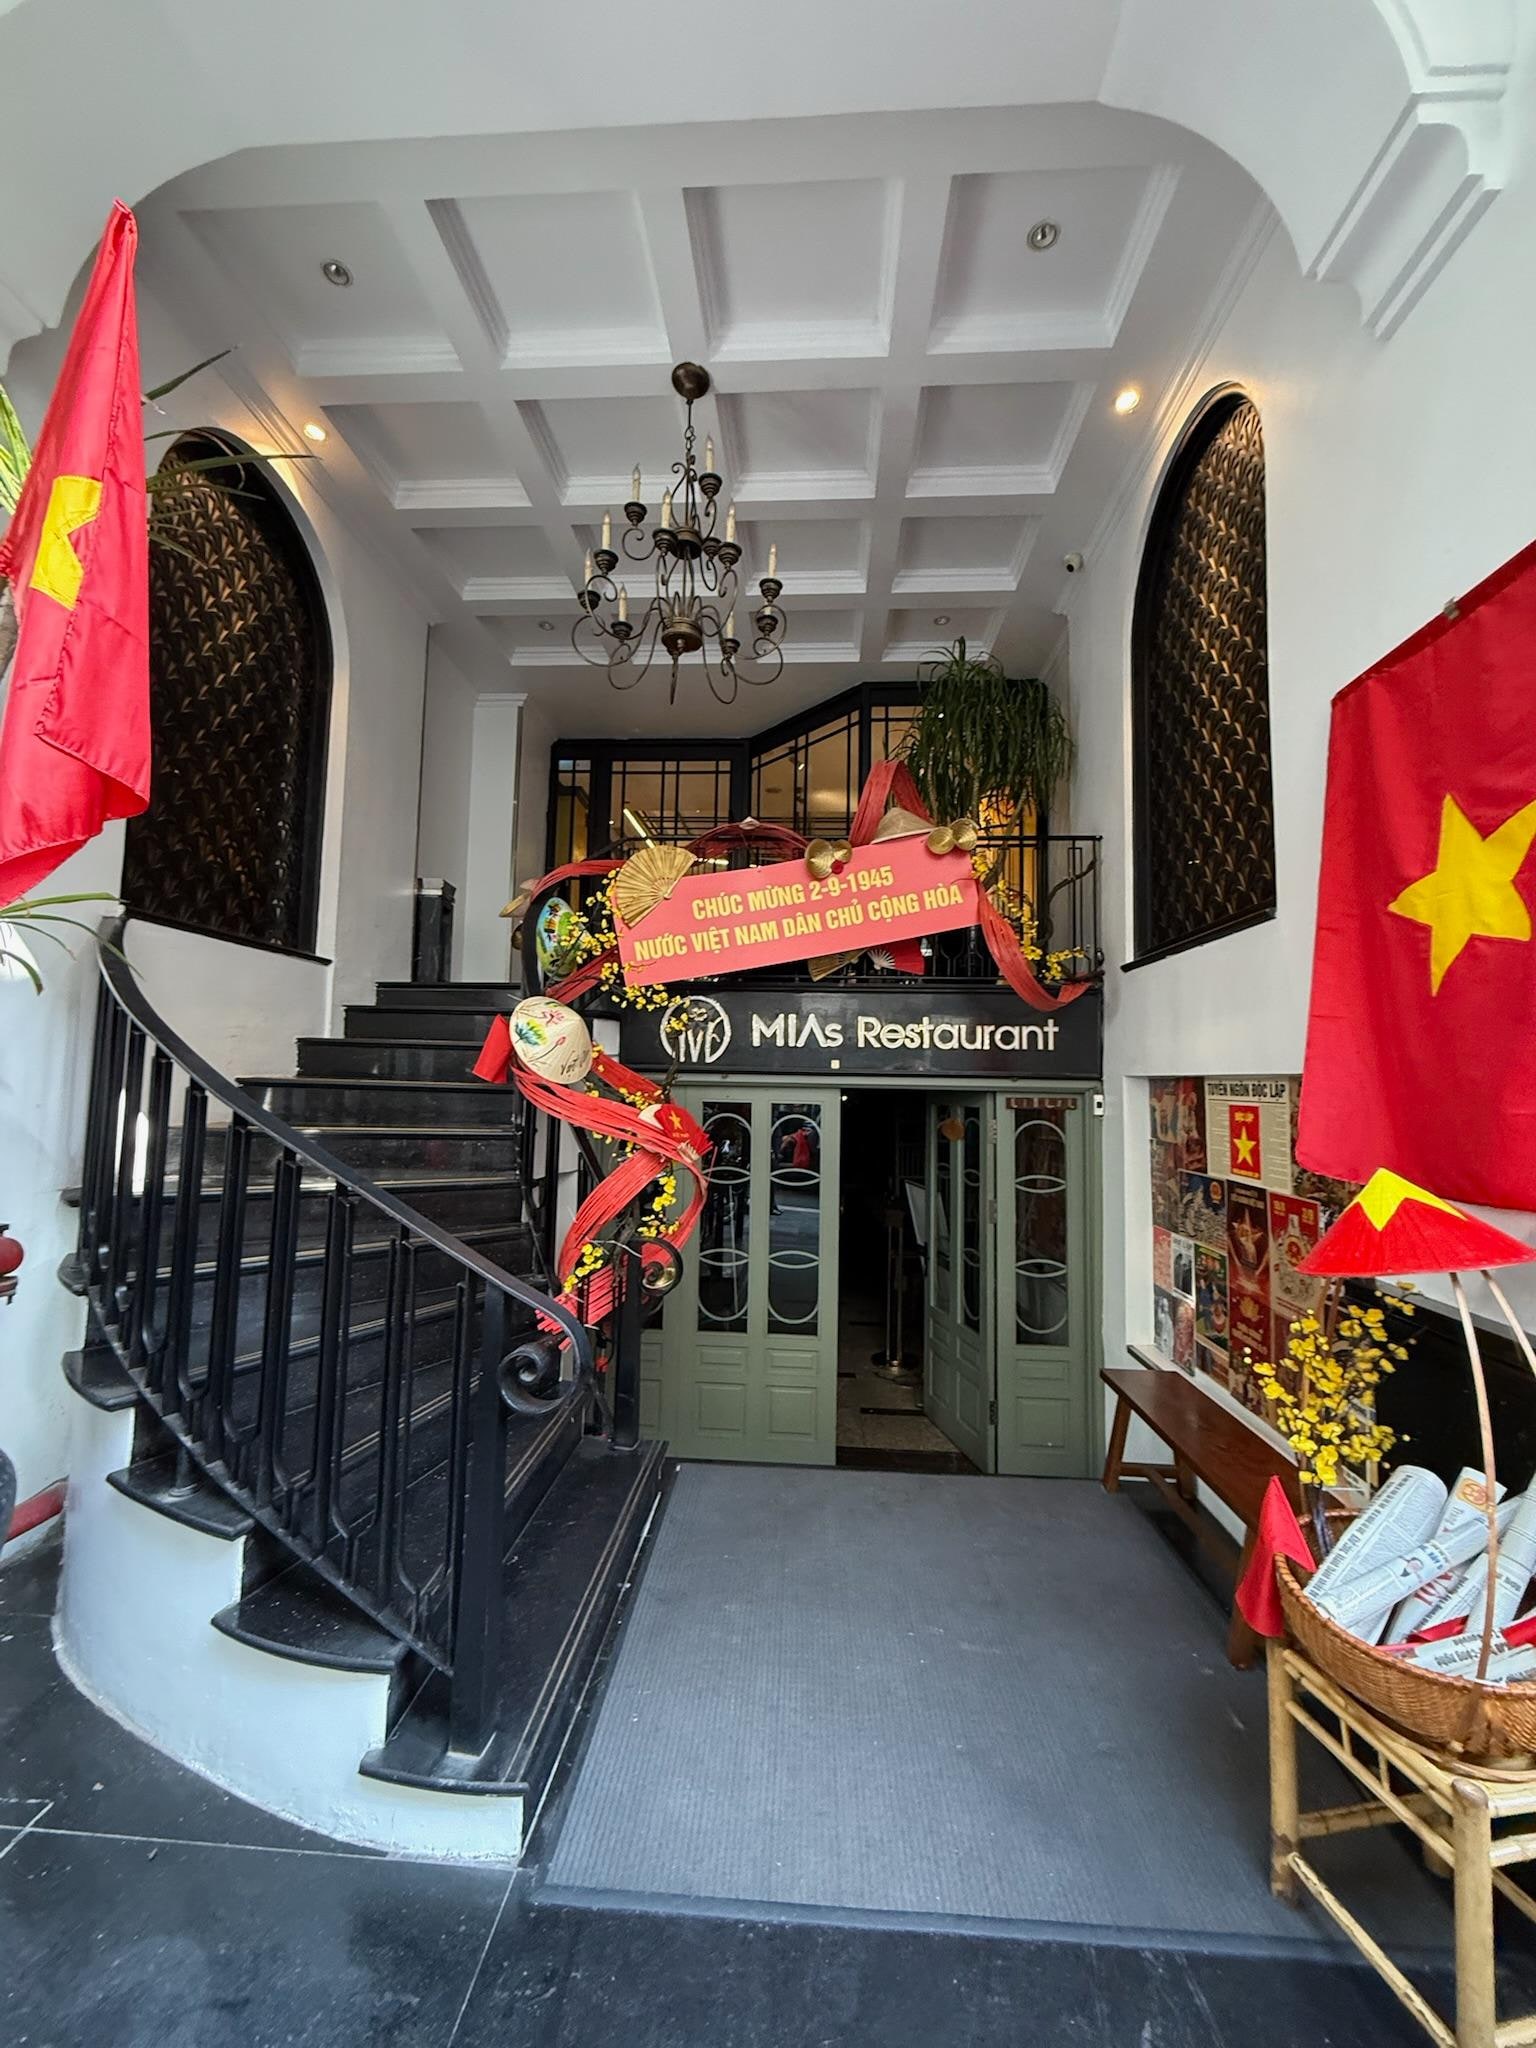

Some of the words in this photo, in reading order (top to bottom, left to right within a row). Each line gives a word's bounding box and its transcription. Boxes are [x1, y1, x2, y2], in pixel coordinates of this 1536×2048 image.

[692, 891, 743, 920] CHÚC
[747, 883, 806, 912] MỪNG
[808, 865, 894, 900] 2-9-1945
[633, 932, 688, 961] NƯỚC
[690, 926, 730, 954] VIỆT
[734, 920, 779, 946] NAM
[782, 912, 822, 938] DÂN
[825, 899, 864, 930] CHỦ
[867, 894, 920, 923] CỘNG
[923, 882, 963, 910] HÒA
[857, 1015, 1059, 1050] Restaurant
